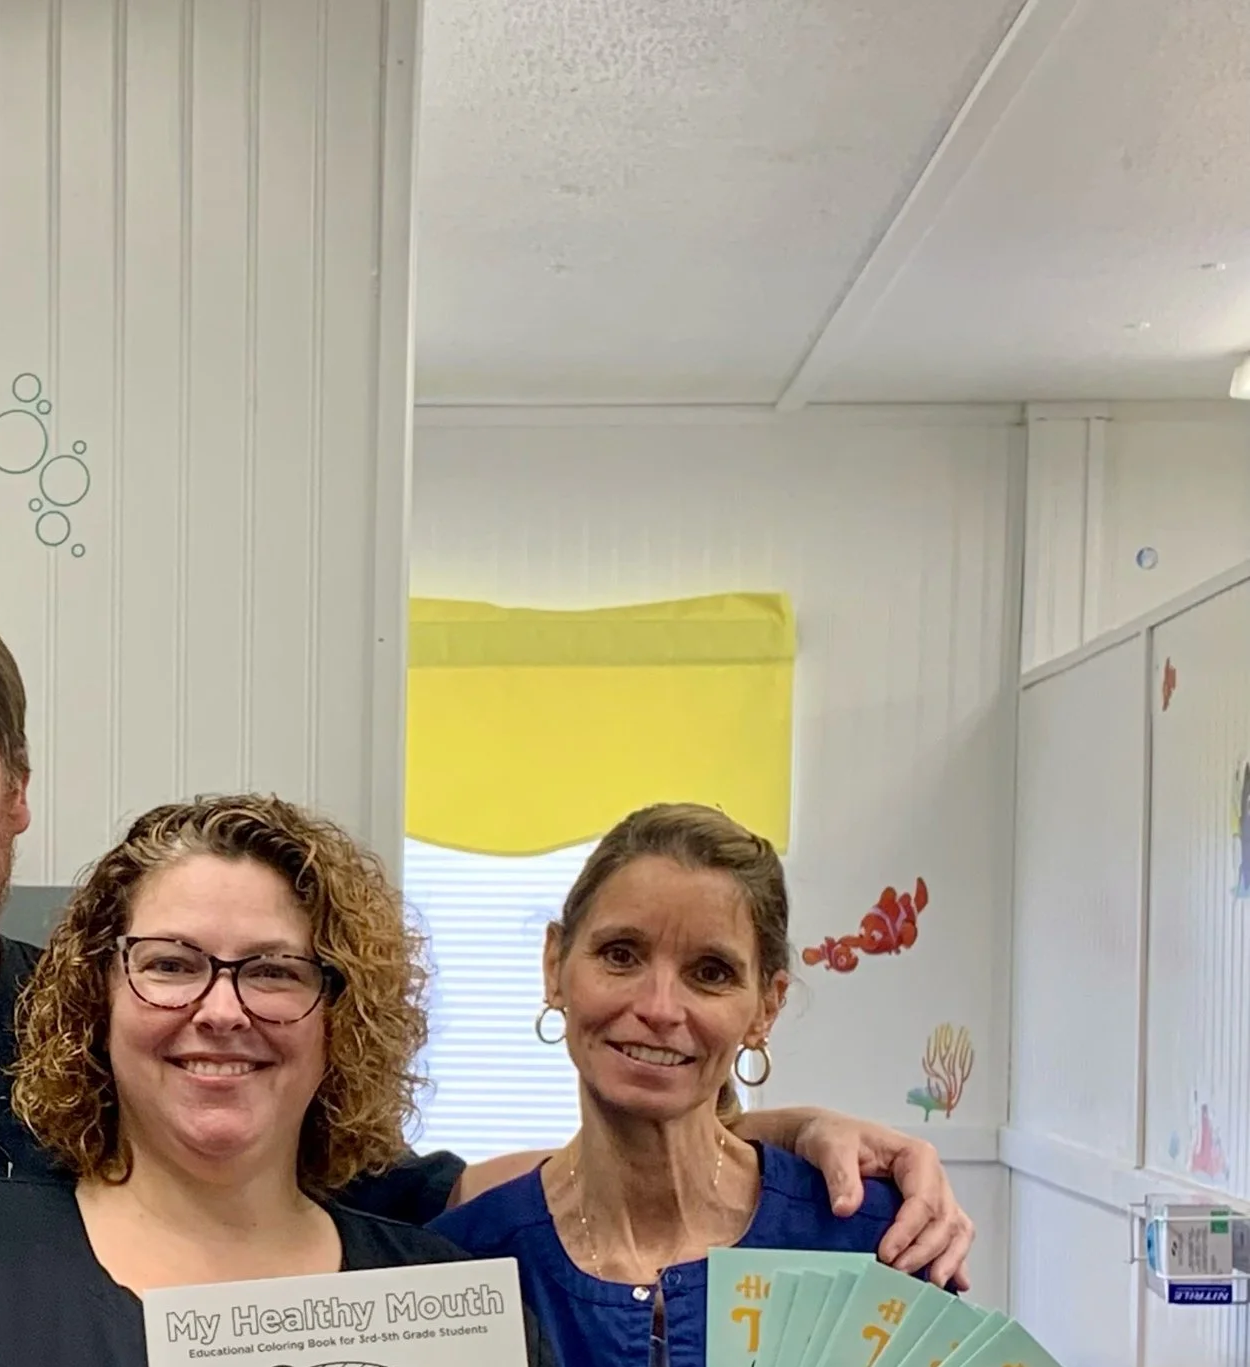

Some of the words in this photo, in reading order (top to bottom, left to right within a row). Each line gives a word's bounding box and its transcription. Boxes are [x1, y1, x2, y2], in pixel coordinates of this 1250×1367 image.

[1174, 1290, 1229, 1301] NITRILE
[166, 1310, 221, 1345] My
[231, 1296, 375, 1337] Healthy
[385, 1284, 504, 1324] Mouth
[188, 1344, 254, 1359] Educational
[256, 1339, 305, 1353] Coloring
[307, 1336, 337, 1349] Book
[339, 1335, 355, 1346] for
[359, 1331, 400, 1344] 3rd-5th
[402, 1328, 437, 1341] Grade
[438, 1325, 489, 1338] Students
